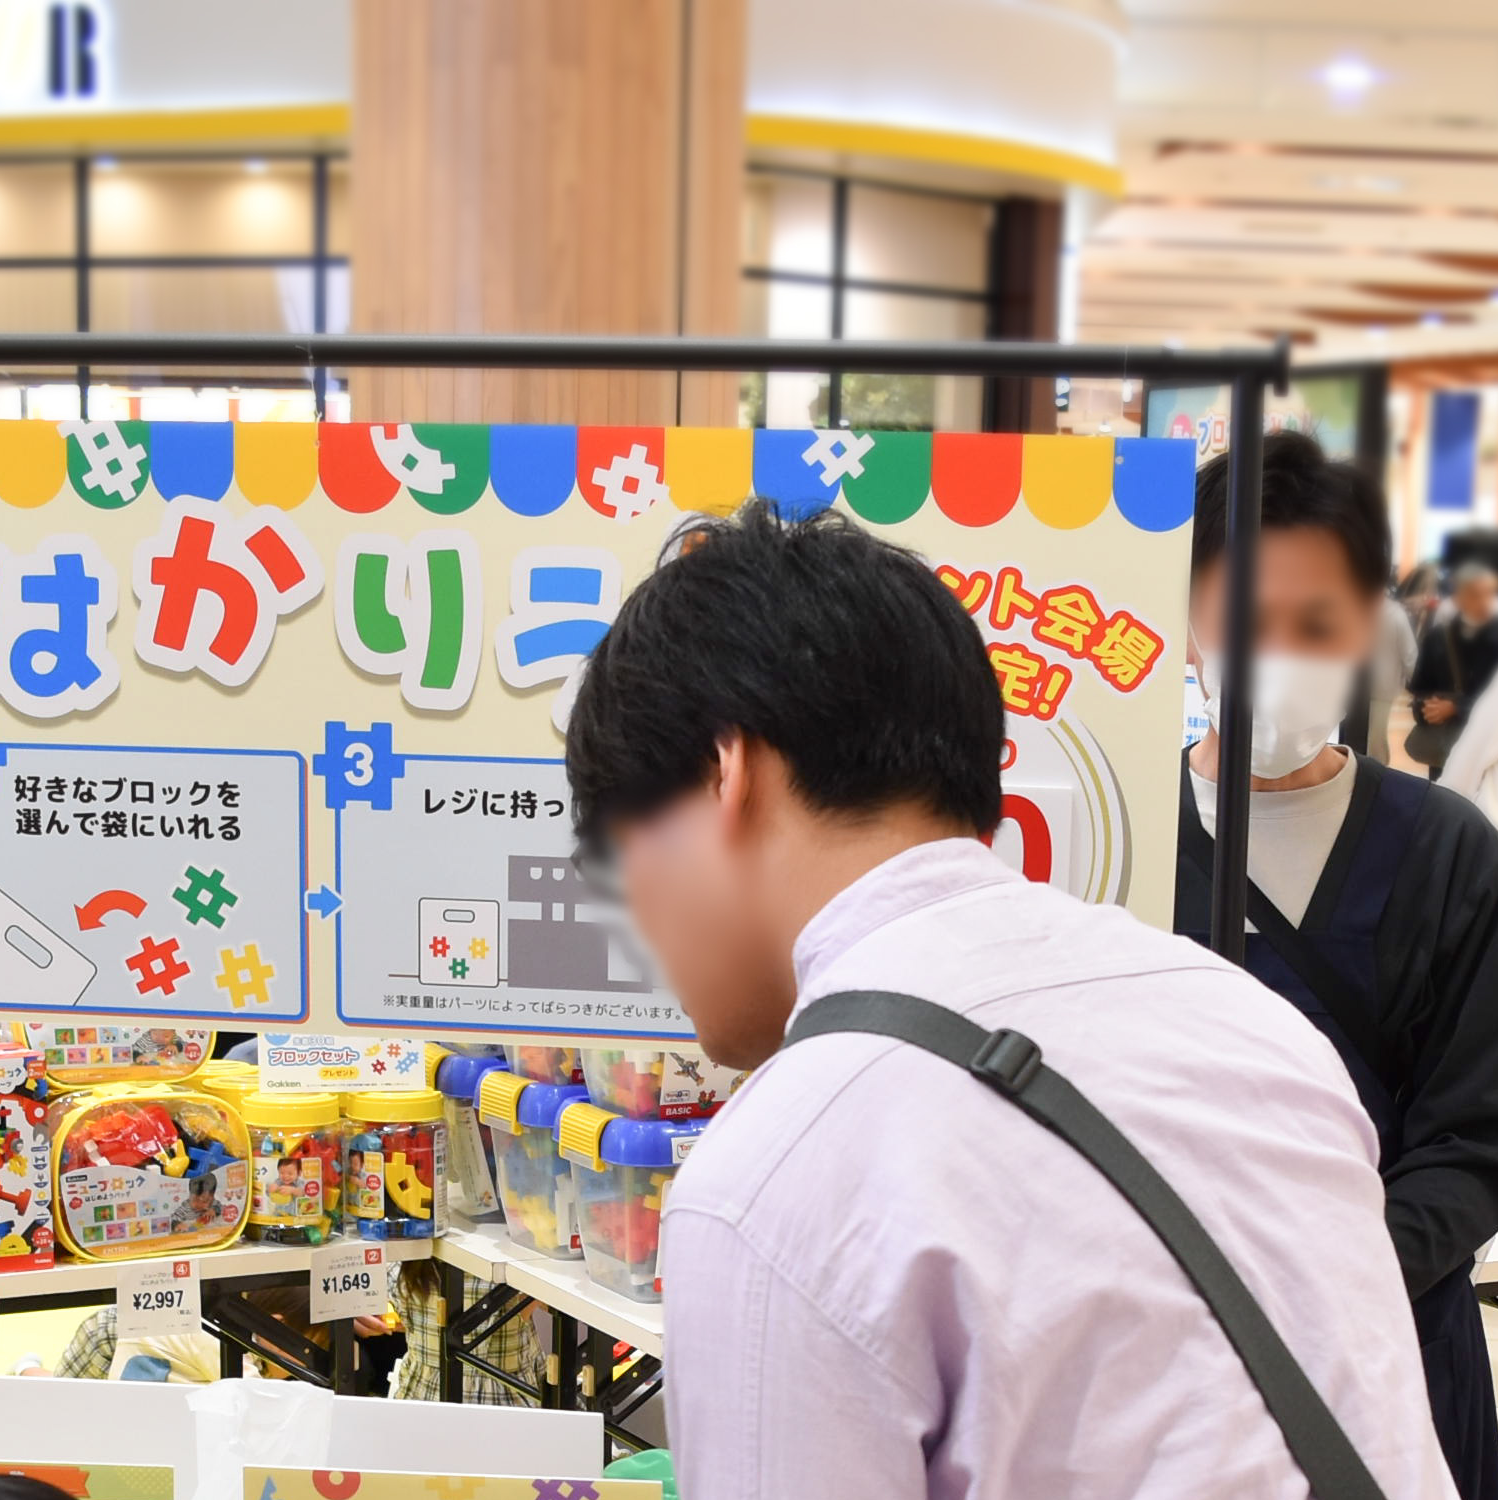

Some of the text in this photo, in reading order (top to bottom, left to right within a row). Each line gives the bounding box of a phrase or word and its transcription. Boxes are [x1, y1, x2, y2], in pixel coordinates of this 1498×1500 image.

[344, 743, 374, 787] 3
[14, 776, 241, 809] 好きなブロックを
[15, 808, 241, 841] 選んで袋にいれる
[270, 1049, 358, 1065] ブロックセット
[267, 1080, 301, 1088] Gakken
[666, 1106, 692, 1116] BASIC
[67, 1175, 146, 1195] ニューブロック
[323, 1273, 370, 1294] ¥1,649
[133, 1290, 184, 1312] ¥2,997
